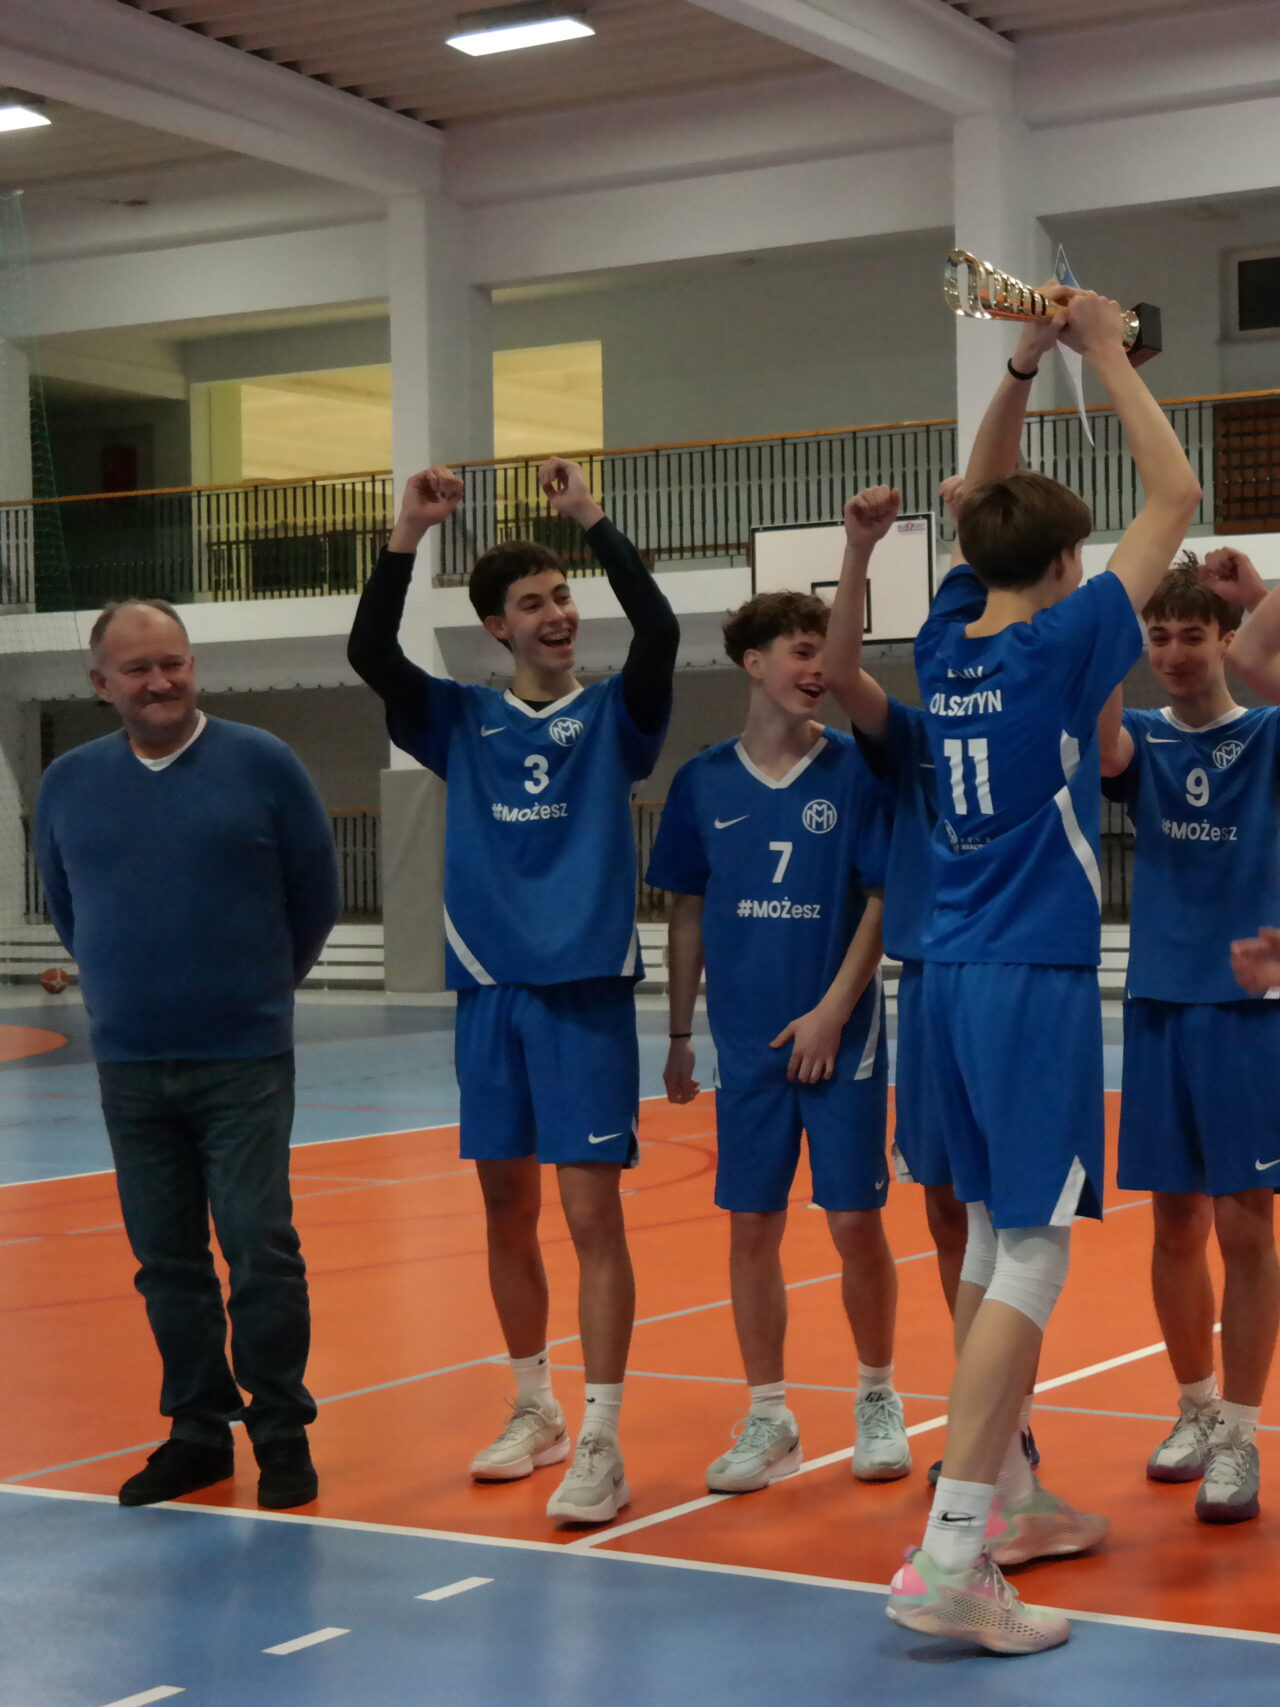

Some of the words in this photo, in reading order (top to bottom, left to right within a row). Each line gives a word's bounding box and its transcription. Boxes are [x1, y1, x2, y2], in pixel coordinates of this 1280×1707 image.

[929, 689, 1003, 716] OLSZTYN
[523, 753, 550, 795] 3
[943, 737, 995, 815] 11
[1185, 767, 1210, 807] 9
[768, 841, 793, 884] 7
